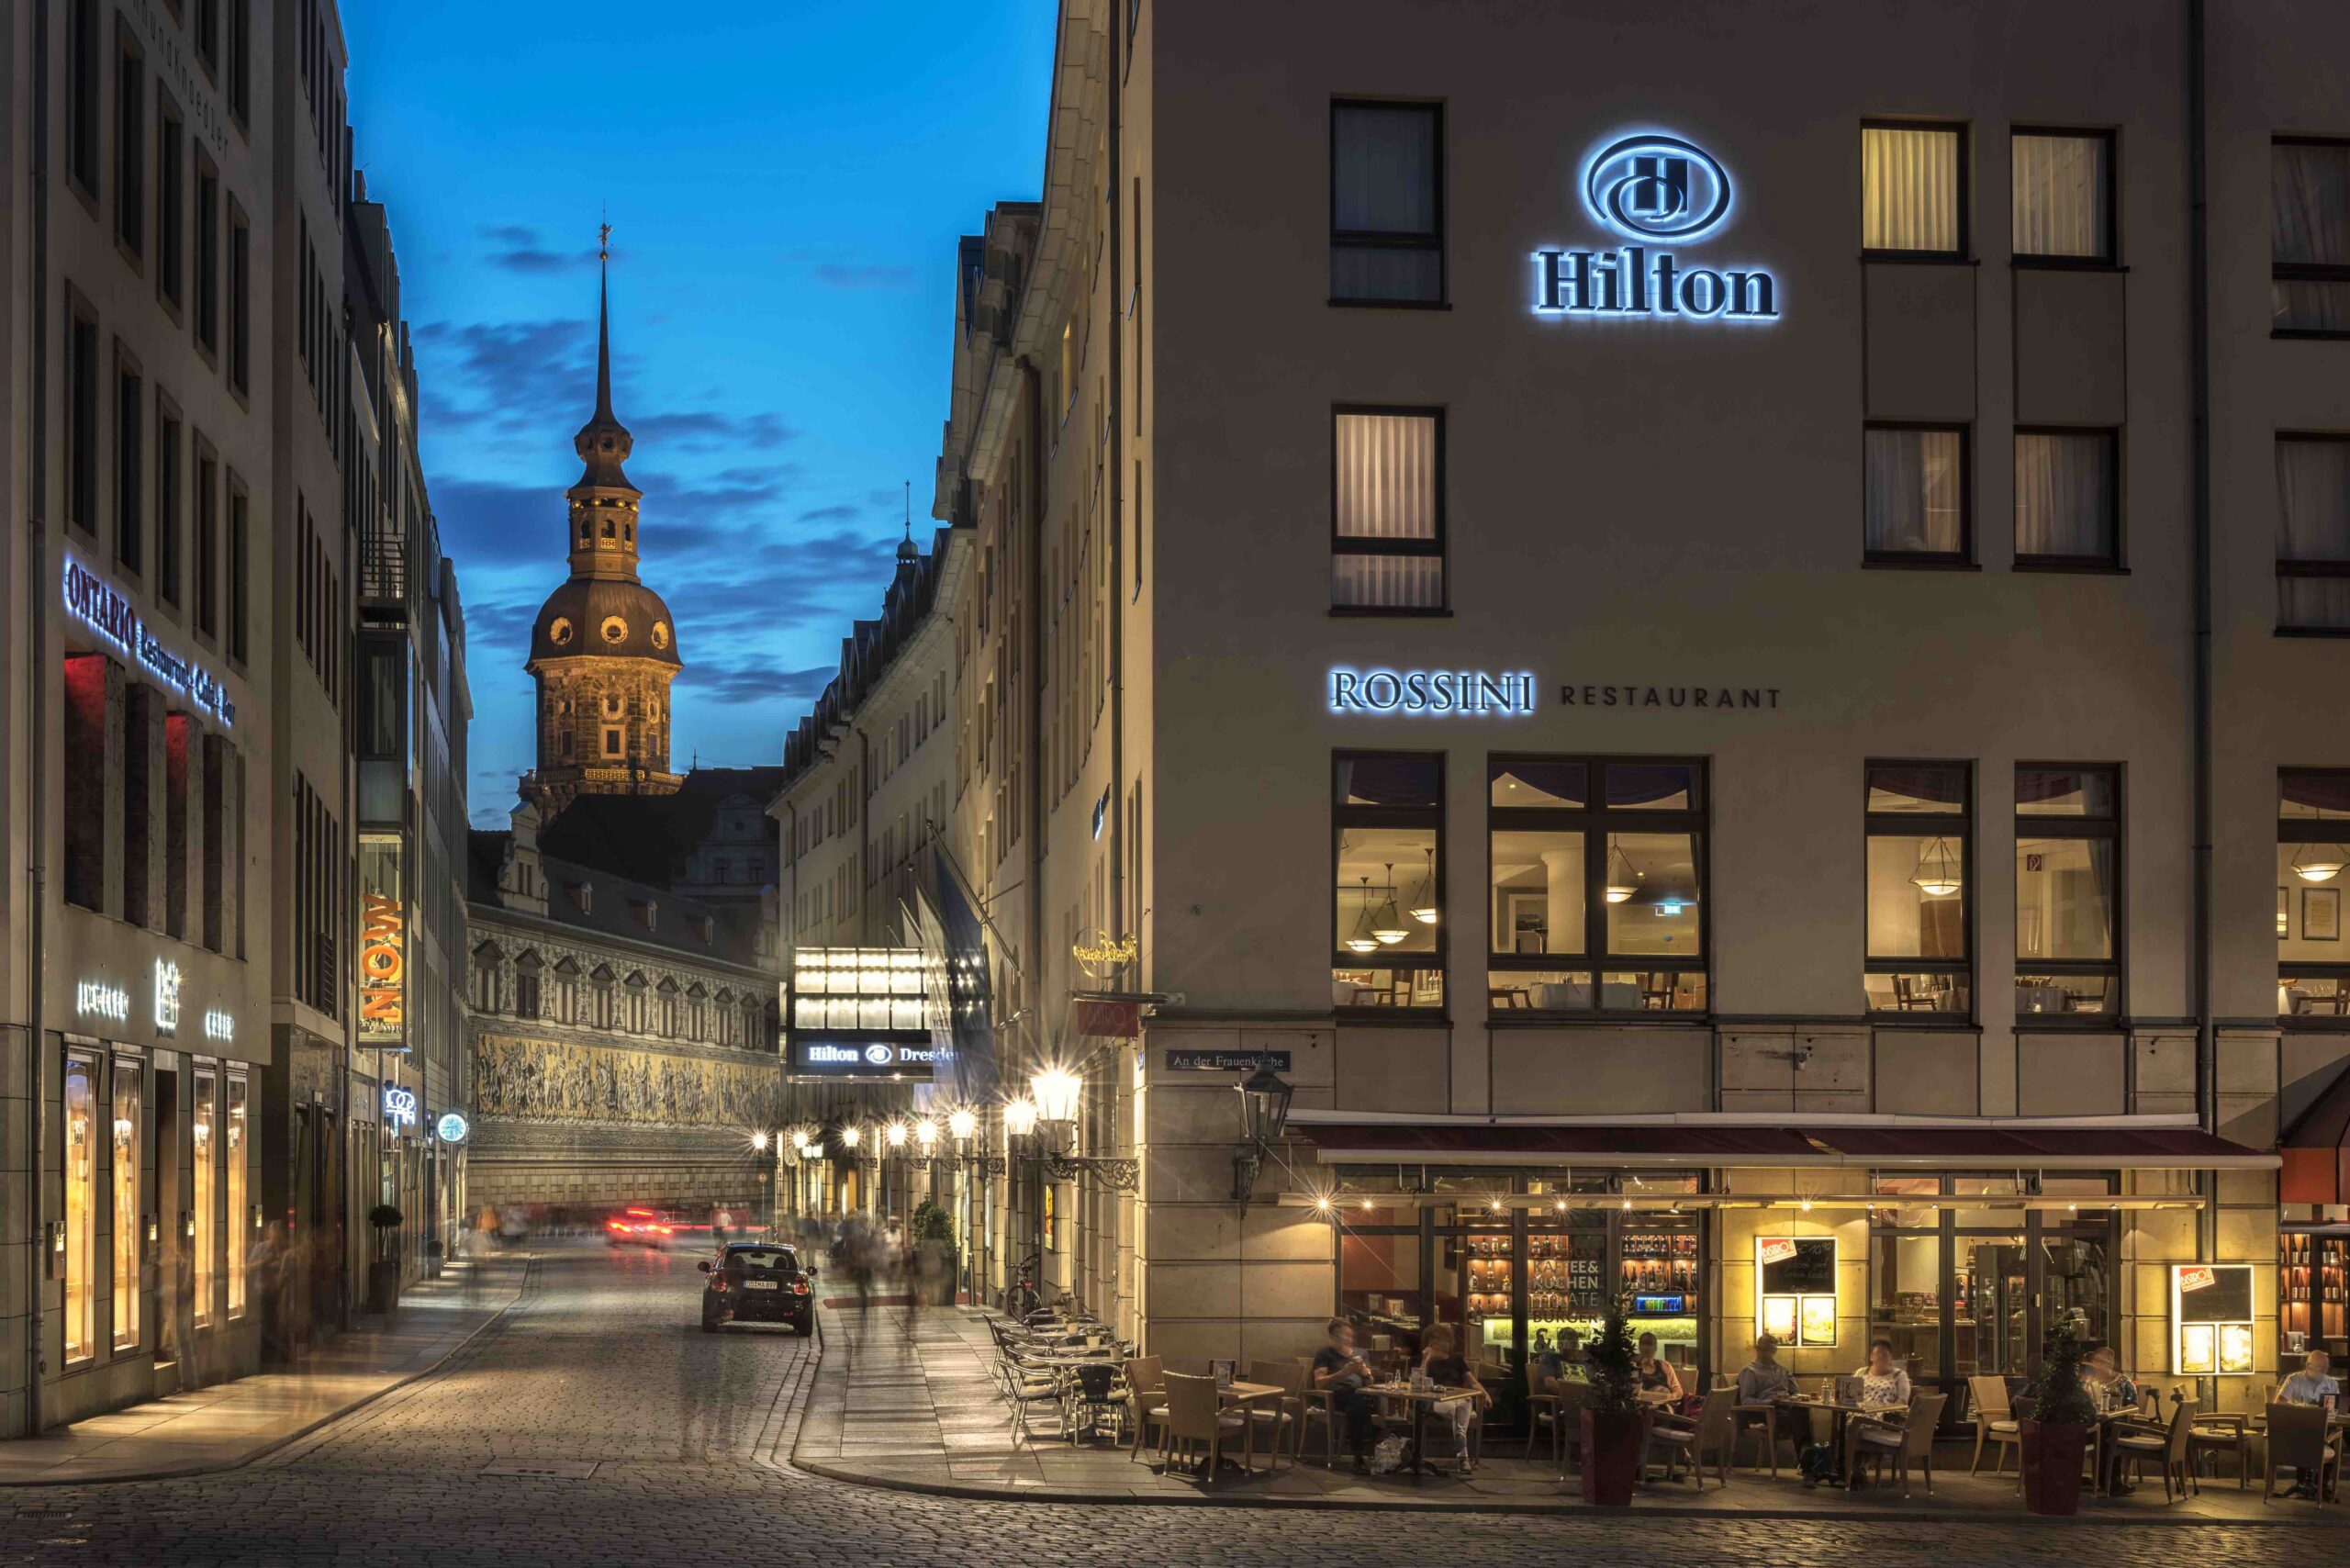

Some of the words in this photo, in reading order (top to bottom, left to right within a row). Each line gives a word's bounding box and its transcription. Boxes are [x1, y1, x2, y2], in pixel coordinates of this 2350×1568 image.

[1533, 246, 1779, 317] Hilton
[67, 562, 135, 650] ONTARIO
[140, 622, 190, 692] Restaurant
[1330, 671, 1536, 712] ROSSINI
[1561, 686, 1780, 709] RESTAURANT
[363, 892, 401, 1021] NOW
[809, 1045, 859, 1061] Hilton
[1173, 1056, 1190, 1066] An
[1194, 1056, 1211, 1066] der
[1215, 1056, 1284, 1067] Frauenkihe
[1534, 1276, 1598, 1289] KUCHEN
[1533, 1309, 1599, 1323] BURGER
